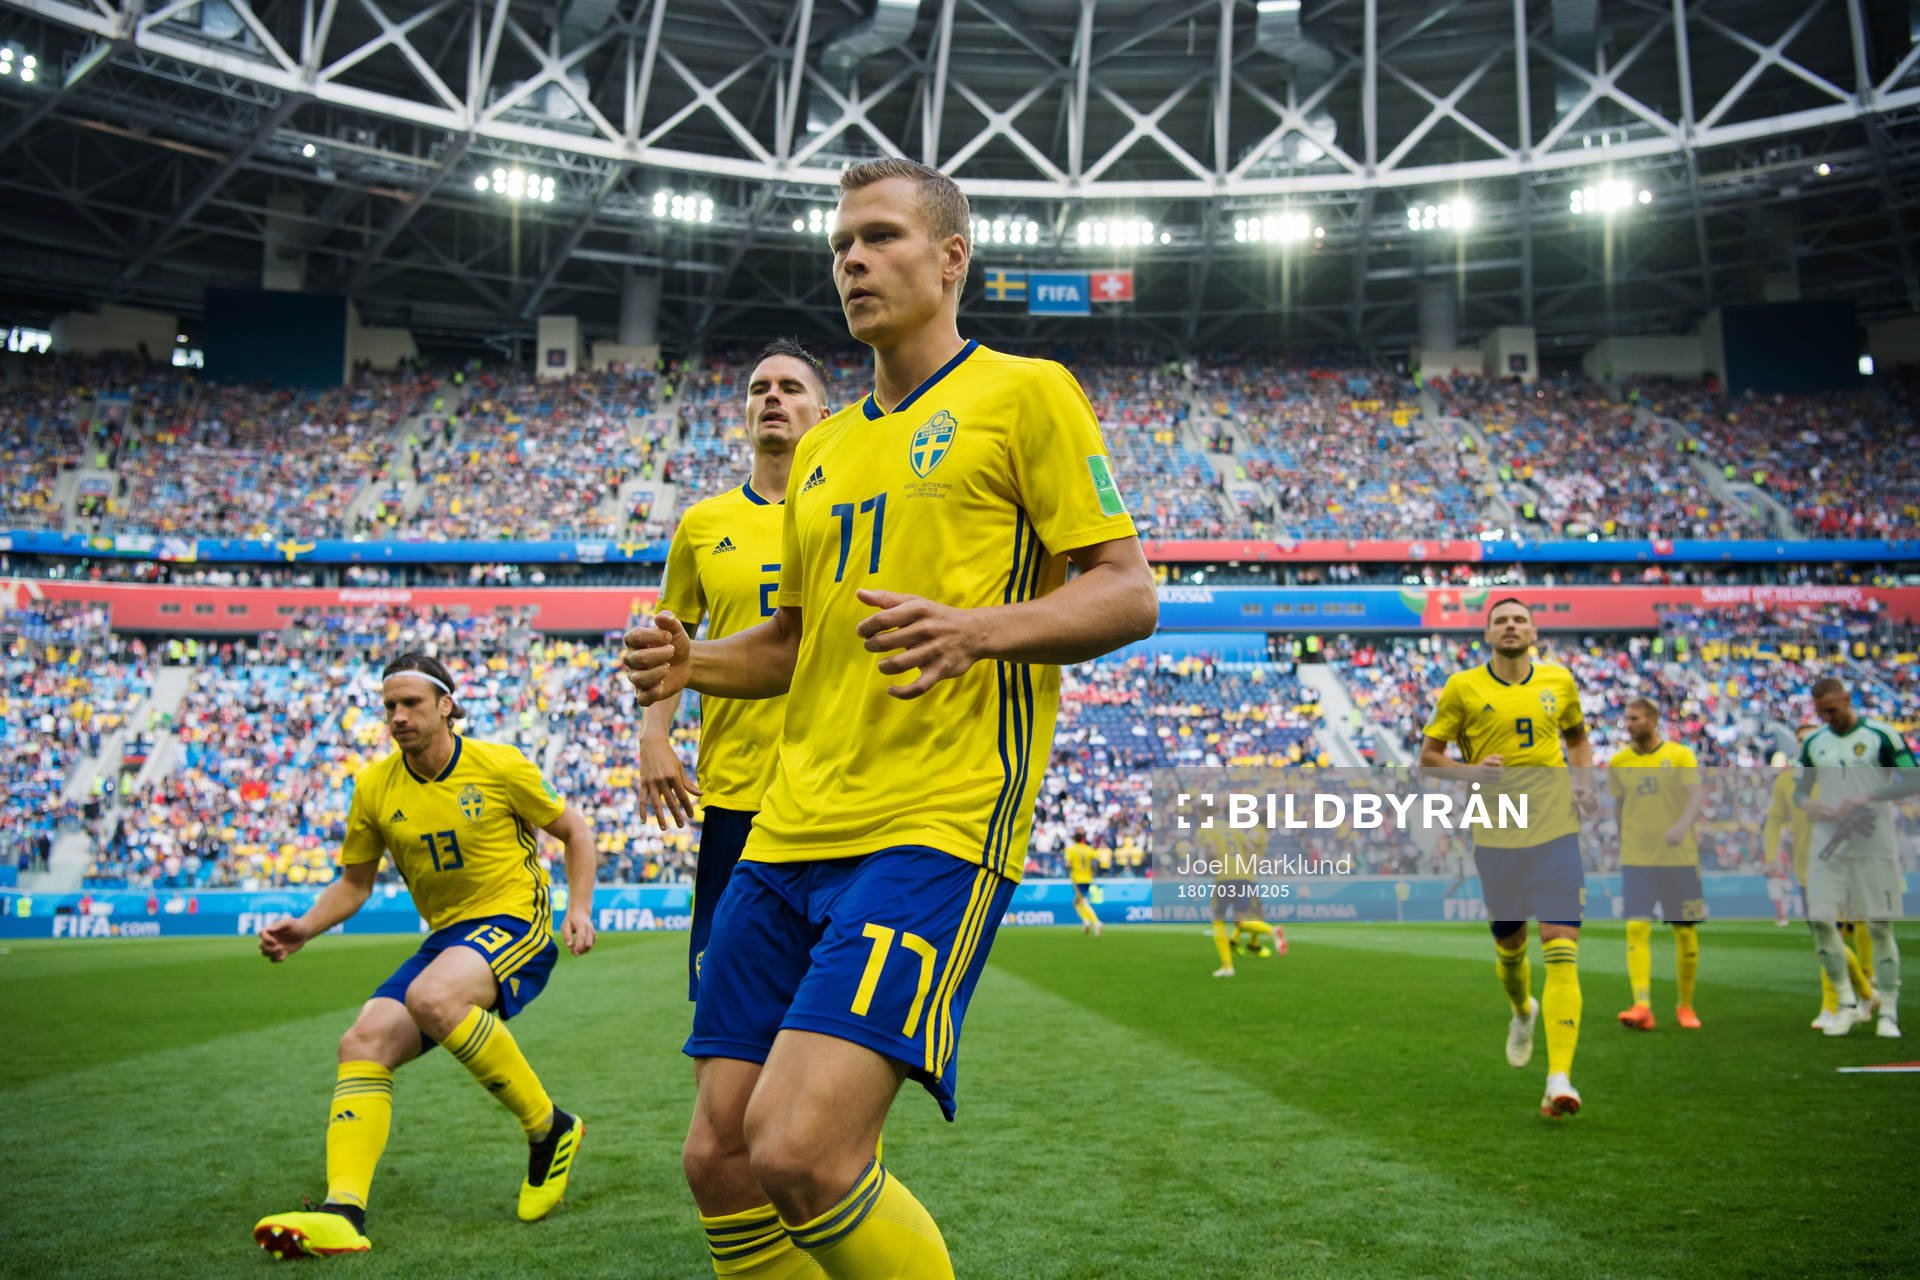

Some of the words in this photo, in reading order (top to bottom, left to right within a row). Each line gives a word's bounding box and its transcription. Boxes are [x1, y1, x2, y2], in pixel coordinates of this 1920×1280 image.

[1037, 285, 1080, 302] FIFA
[1515, 718, 1535, 748] 9
[1637, 775, 1660, 796] 20
[420, 829, 464, 872] 13
[53, 914, 160, 937] FIFA.com
[464, 924, 513, 954] 13
